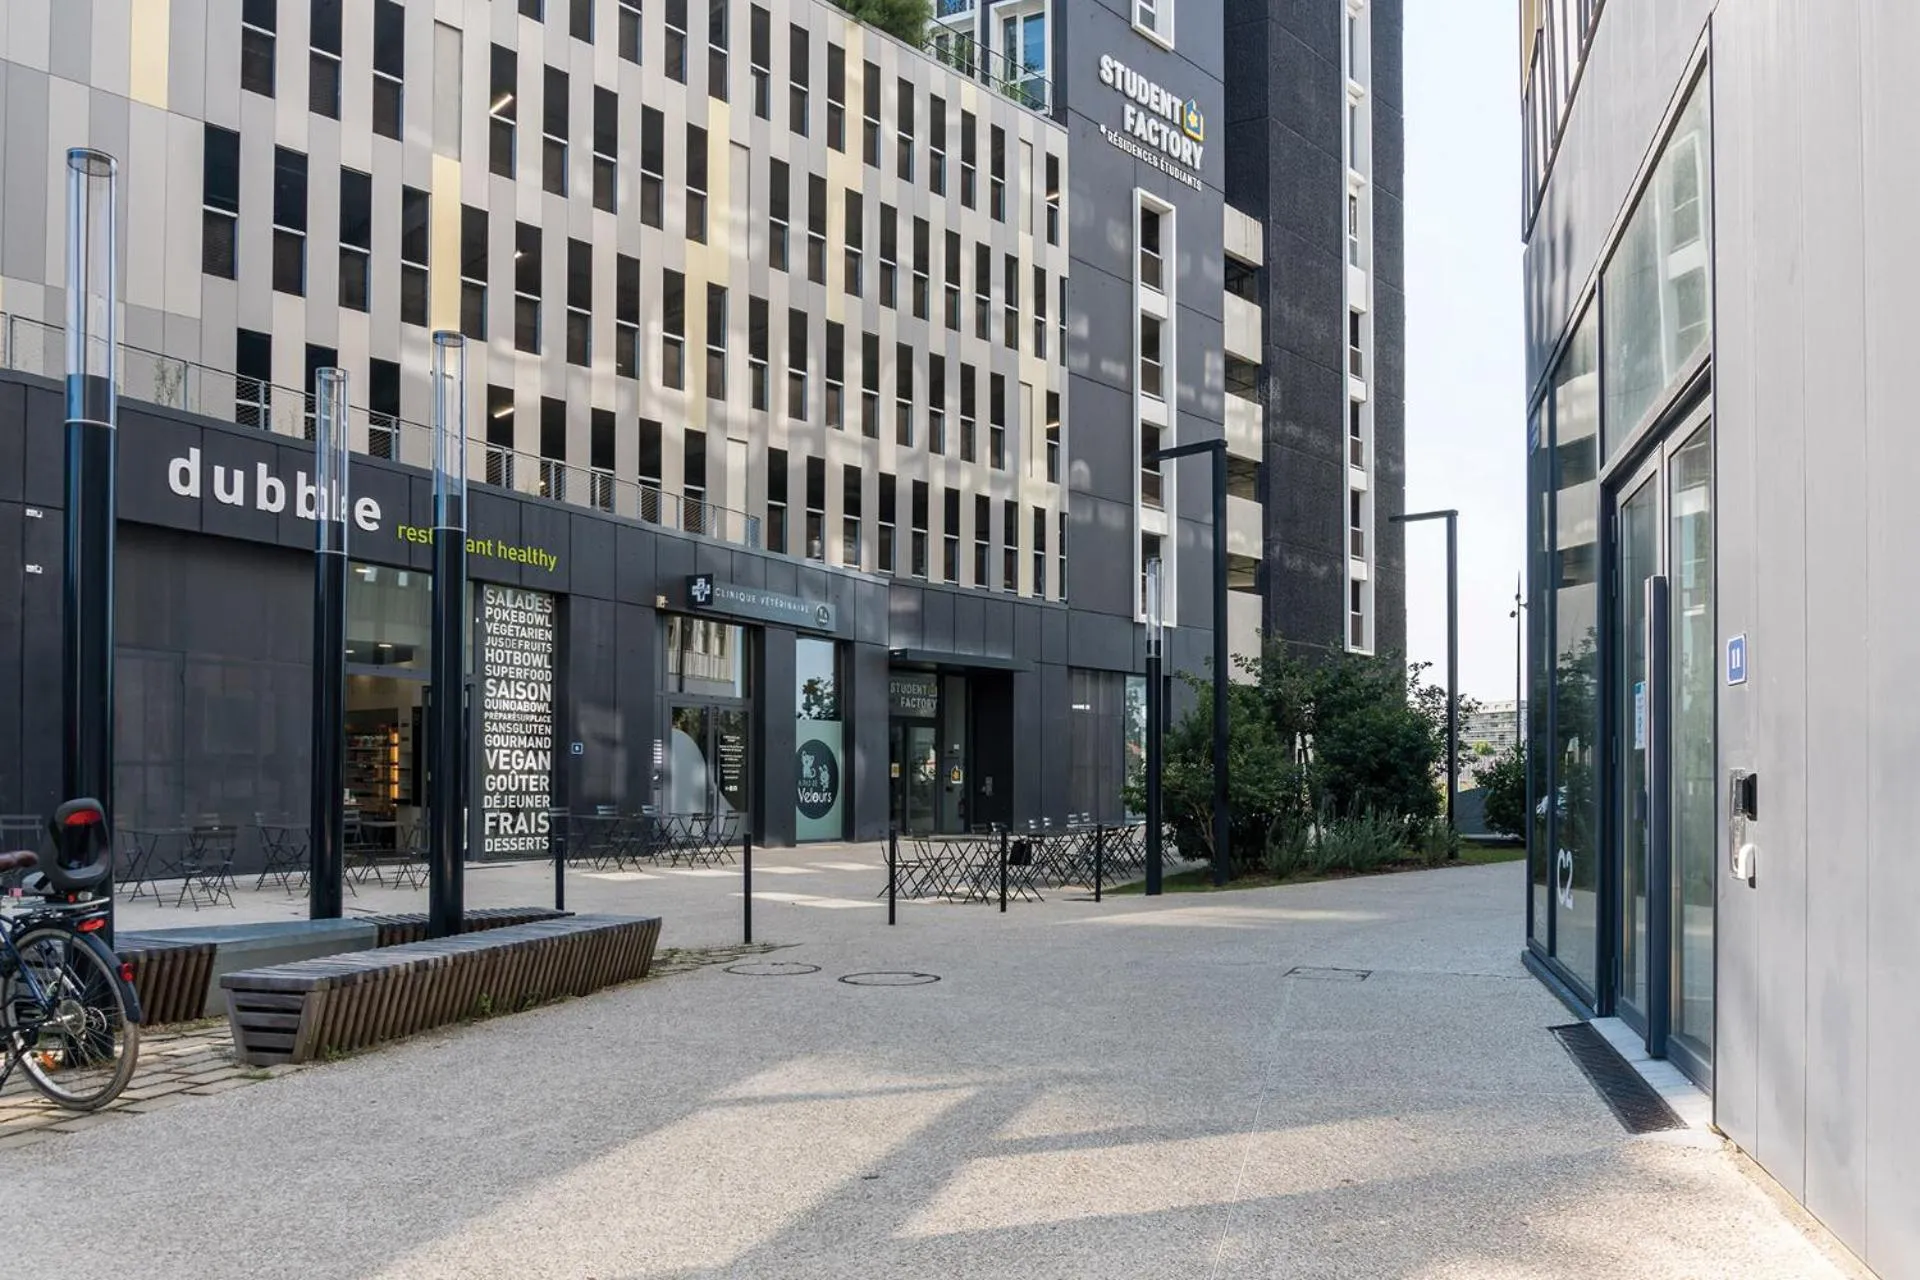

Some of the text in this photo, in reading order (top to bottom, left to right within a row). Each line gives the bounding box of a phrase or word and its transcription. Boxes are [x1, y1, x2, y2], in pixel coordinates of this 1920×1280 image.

[1099, 54, 1183, 124] STUDENT
[1123, 103, 1203, 170] FACTORY
[1107, 130, 1202, 191] RÉSIDENCES ÉTUDIANTS
[397, 525, 558, 572] restant healthy
[485, 589, 552, 614] SALADES
[715, 587, 757, 604] CLINIQUE
[485, 619, 552, 641] VÉGÉTARIEN
[485, 648, 552, 669] HOTBOWL
[485, 664, 552, 682] SUPERFOOD
[485, 678, 552, 702] SAISON
[890, 681, 928, 695] STUDENT
[484, 698, 551, 713] QUINOABOWL
[900, 697, 938, 710] FACTORY
[484, 734, 552, 749] GOURMAND
[485, 749, 551, 770] VEGAN
[485, 770, 550, 792] GOÛTER
[484, 792, 550, 808] DÉJEUNER
[797, 787, 832, 804] Velours
[484, 812, 550, 835] FRAIS
[484, 837, 549, 852] DESSERTS
